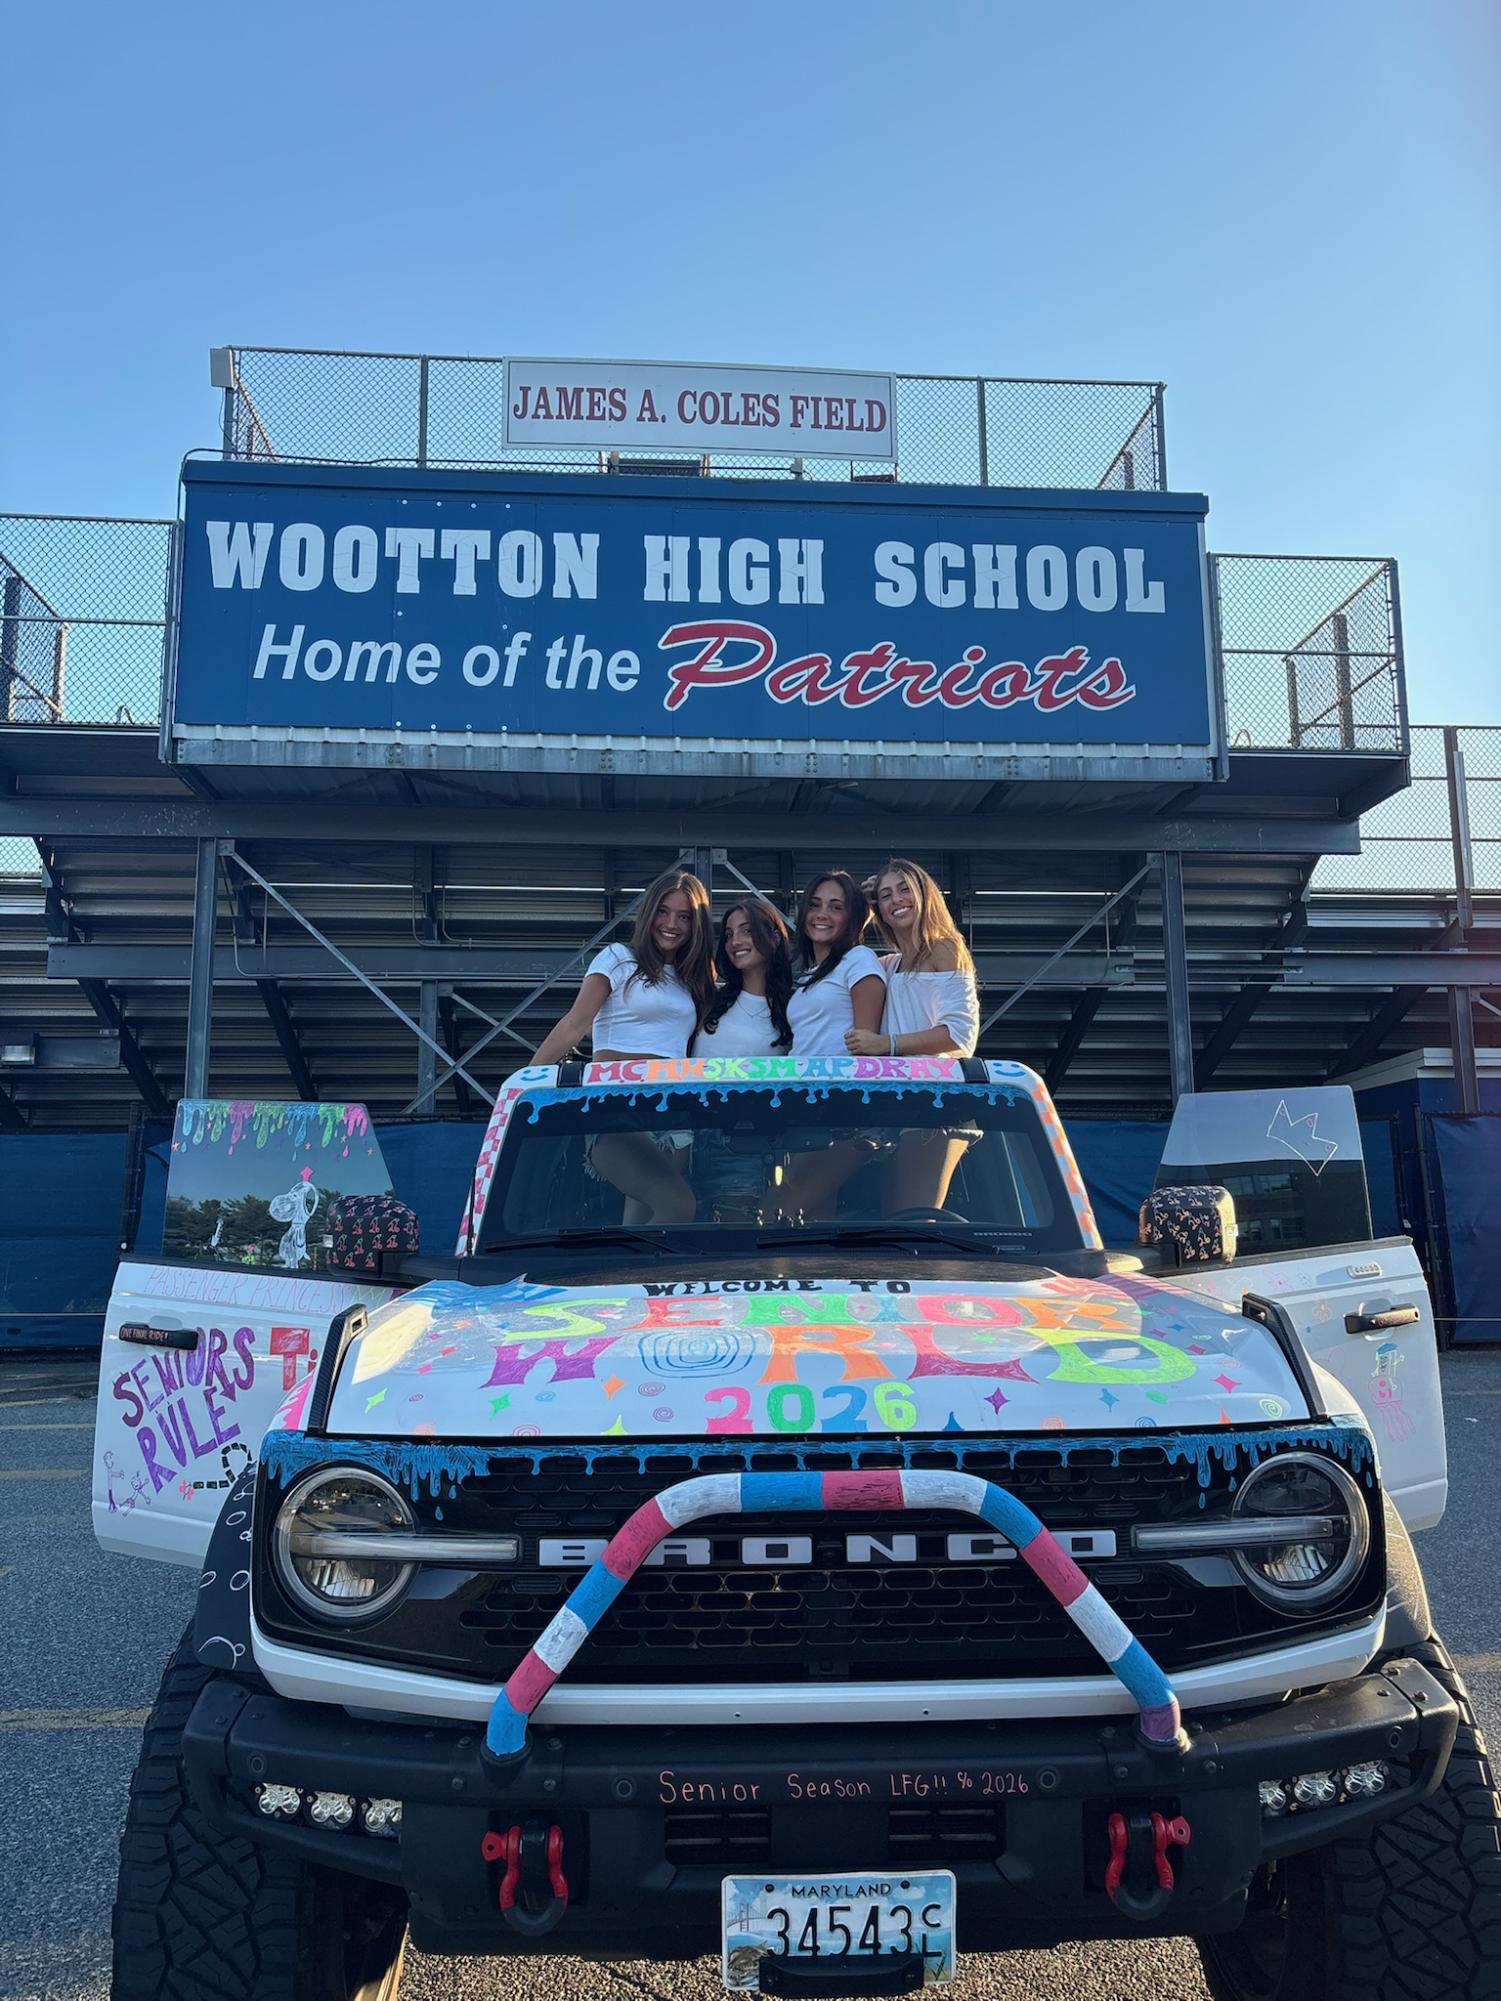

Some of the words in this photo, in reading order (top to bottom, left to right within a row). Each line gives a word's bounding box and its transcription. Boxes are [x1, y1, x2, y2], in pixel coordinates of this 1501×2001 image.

[513, 385, 628, 423] JAMES
[636, 388, 668, 424] A.
[677, 390, 781, 428] COLES
[789, 395, 887, 433] FIELD
[205, 520, 600, 600] WOOTTON
[643, 534, 826, 605] HIGH
[873, 540, 1167, 614] SCHOOL
[252, 623, 441, 686] Home
[462, 631, 532, 688] of
[544, 634, 641, 691] the
[657, 618, 1137, 713] Patriots
[144, 1266, 250, 1306] PASSENGER
[642, 1279, 823, 1297] WELCOME
[849, 1280, 912, 1294] TO
[503, 1292, 1143, 1342] SENIOR
[112, 1326, 257, 1428] SENIORS
[479, 1323, 1198, 1389] WORLD
[704, 1381, 918, 1434] 2026
[136, 1386, 242, 1494] RULE
[538, 1529, 1117, 1567] BRONCO
[659, 1770, 761, 1804] Senior
[787, 1773, 871, 1798] Season
[889, 1773, 948, 1796] LFG!!
[982, 1771, 1029, 1794] 2026
[791, 1882, 892, 1899] MARYLAND
[766, 1904, 912, 1957] 34543
